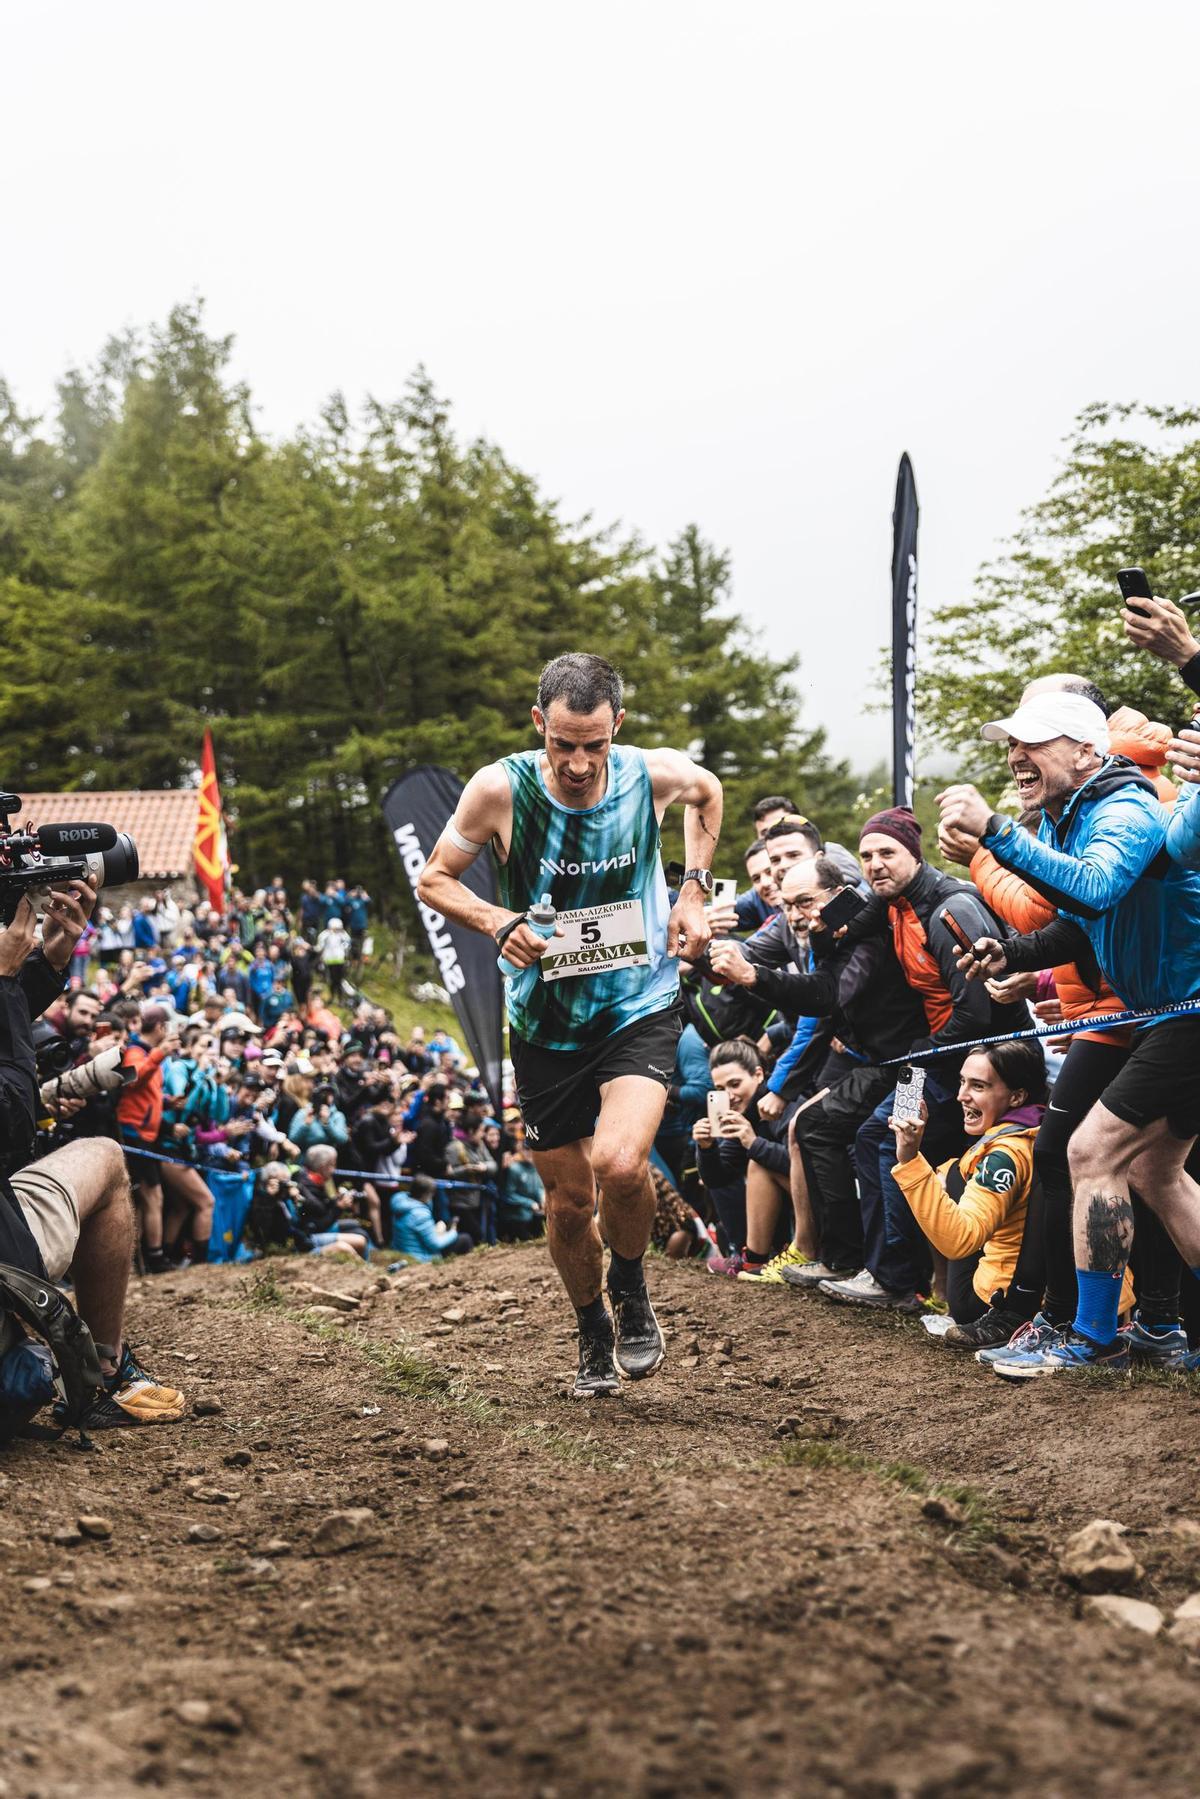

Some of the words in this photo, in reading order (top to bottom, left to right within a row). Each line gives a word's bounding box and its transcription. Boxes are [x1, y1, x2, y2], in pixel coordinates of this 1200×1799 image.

[59, 828, 100, 842] RØDE
[581, 920, 602, 944] 5
[580, 942, 605, 951] KILIAN
[552, 944, 636, 968] ZEGAMA
[577, 963, 614, 973] SALOMON
